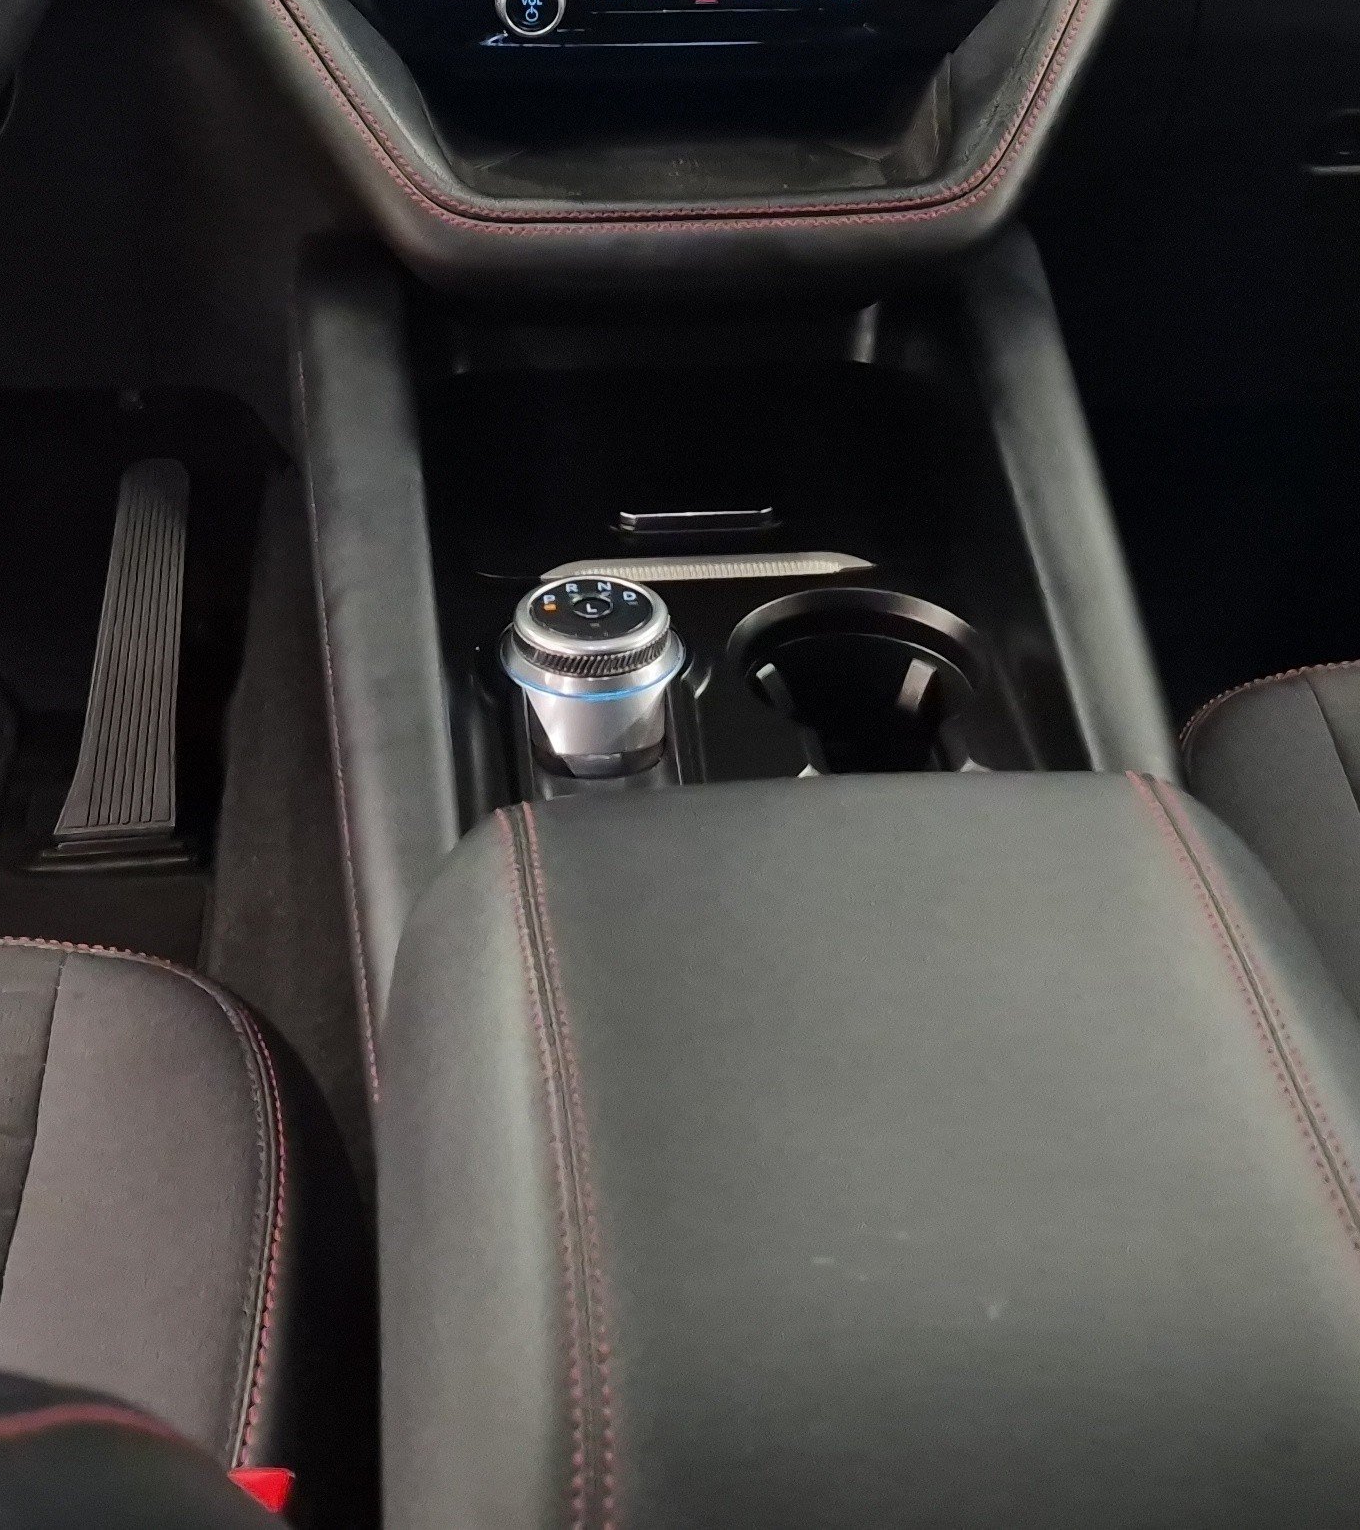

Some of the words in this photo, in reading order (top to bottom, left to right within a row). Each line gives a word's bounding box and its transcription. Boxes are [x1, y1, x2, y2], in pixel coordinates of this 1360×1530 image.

[543, 594, 556, 604] P
[565, 583, 579, 592] R
[597, 582, 612, 591] N
[622, 591, 637, 601] D
[586, 603, 598, 613] L
